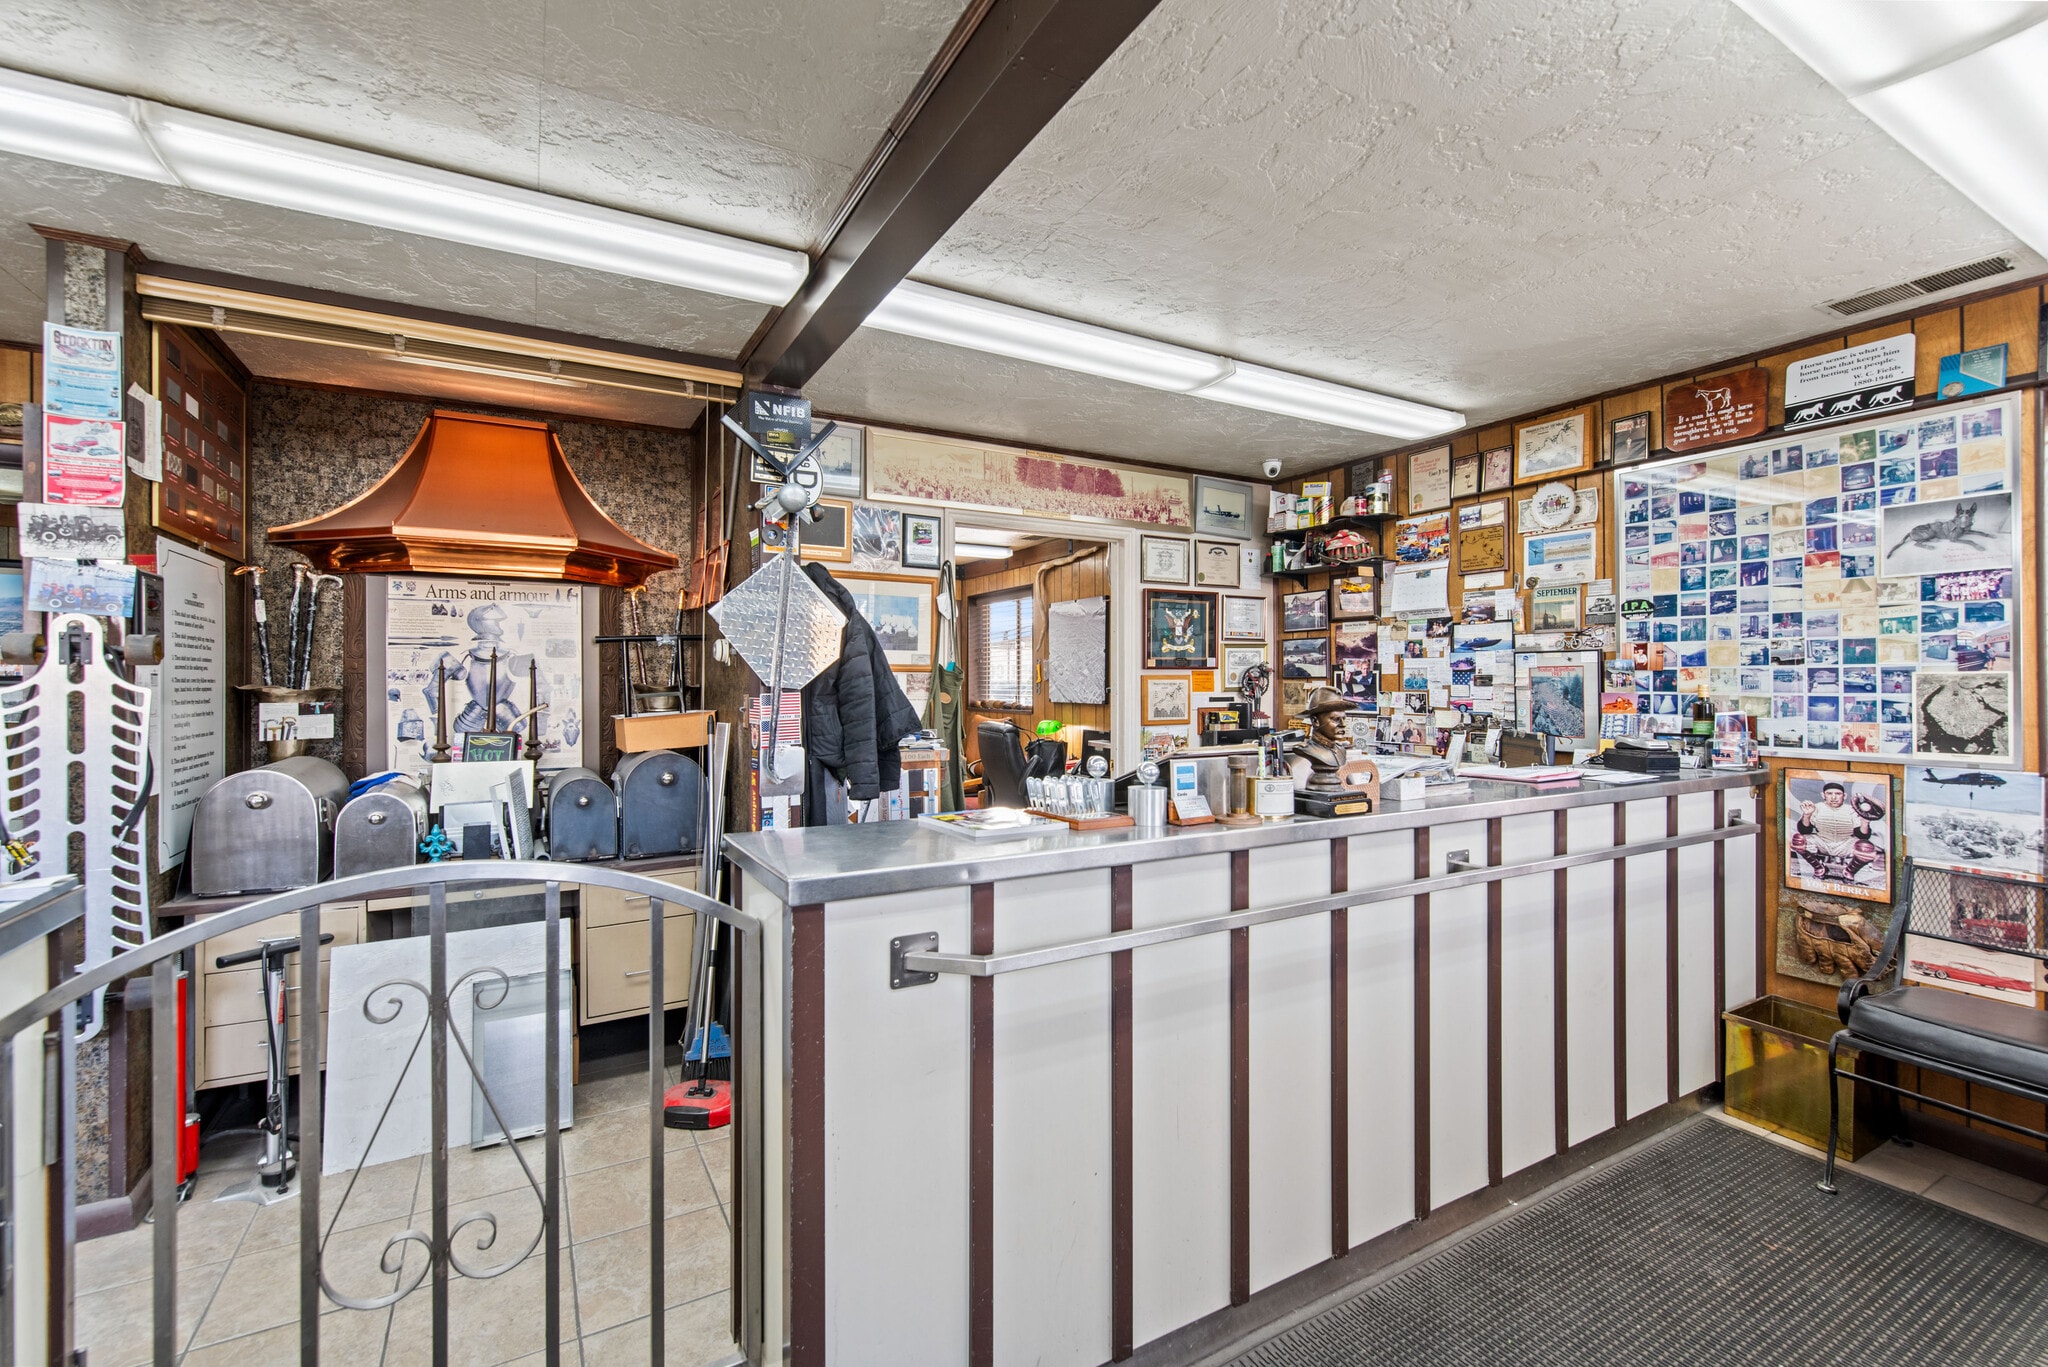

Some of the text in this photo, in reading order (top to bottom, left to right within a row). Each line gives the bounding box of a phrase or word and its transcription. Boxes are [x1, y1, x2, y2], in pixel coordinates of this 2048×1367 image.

[54, 330, 112, 351] STOCKTON
[1800, 361, 1823, 370] Horse
[1826, 355, 1847, 364] sense
[1859, 348, 1878, 356] what
[1800, 369, 1821, 377] horse
[1857, 354, 1880, 364] keeps
[1821, 369, 1849, 378] betting
[1864, 358, 1896, 369] people.
[1877, 365, 1901, 374] Fields
[773, 404, 805, 418] NFIB
[426, 584, 550, 602] Arms and armour
[1537, 588, 1577, 597] SEPTEMBER
[1624, 601, 1649, 610] IPA
[1807, 880, 1870, 896] YOGI BERRA
